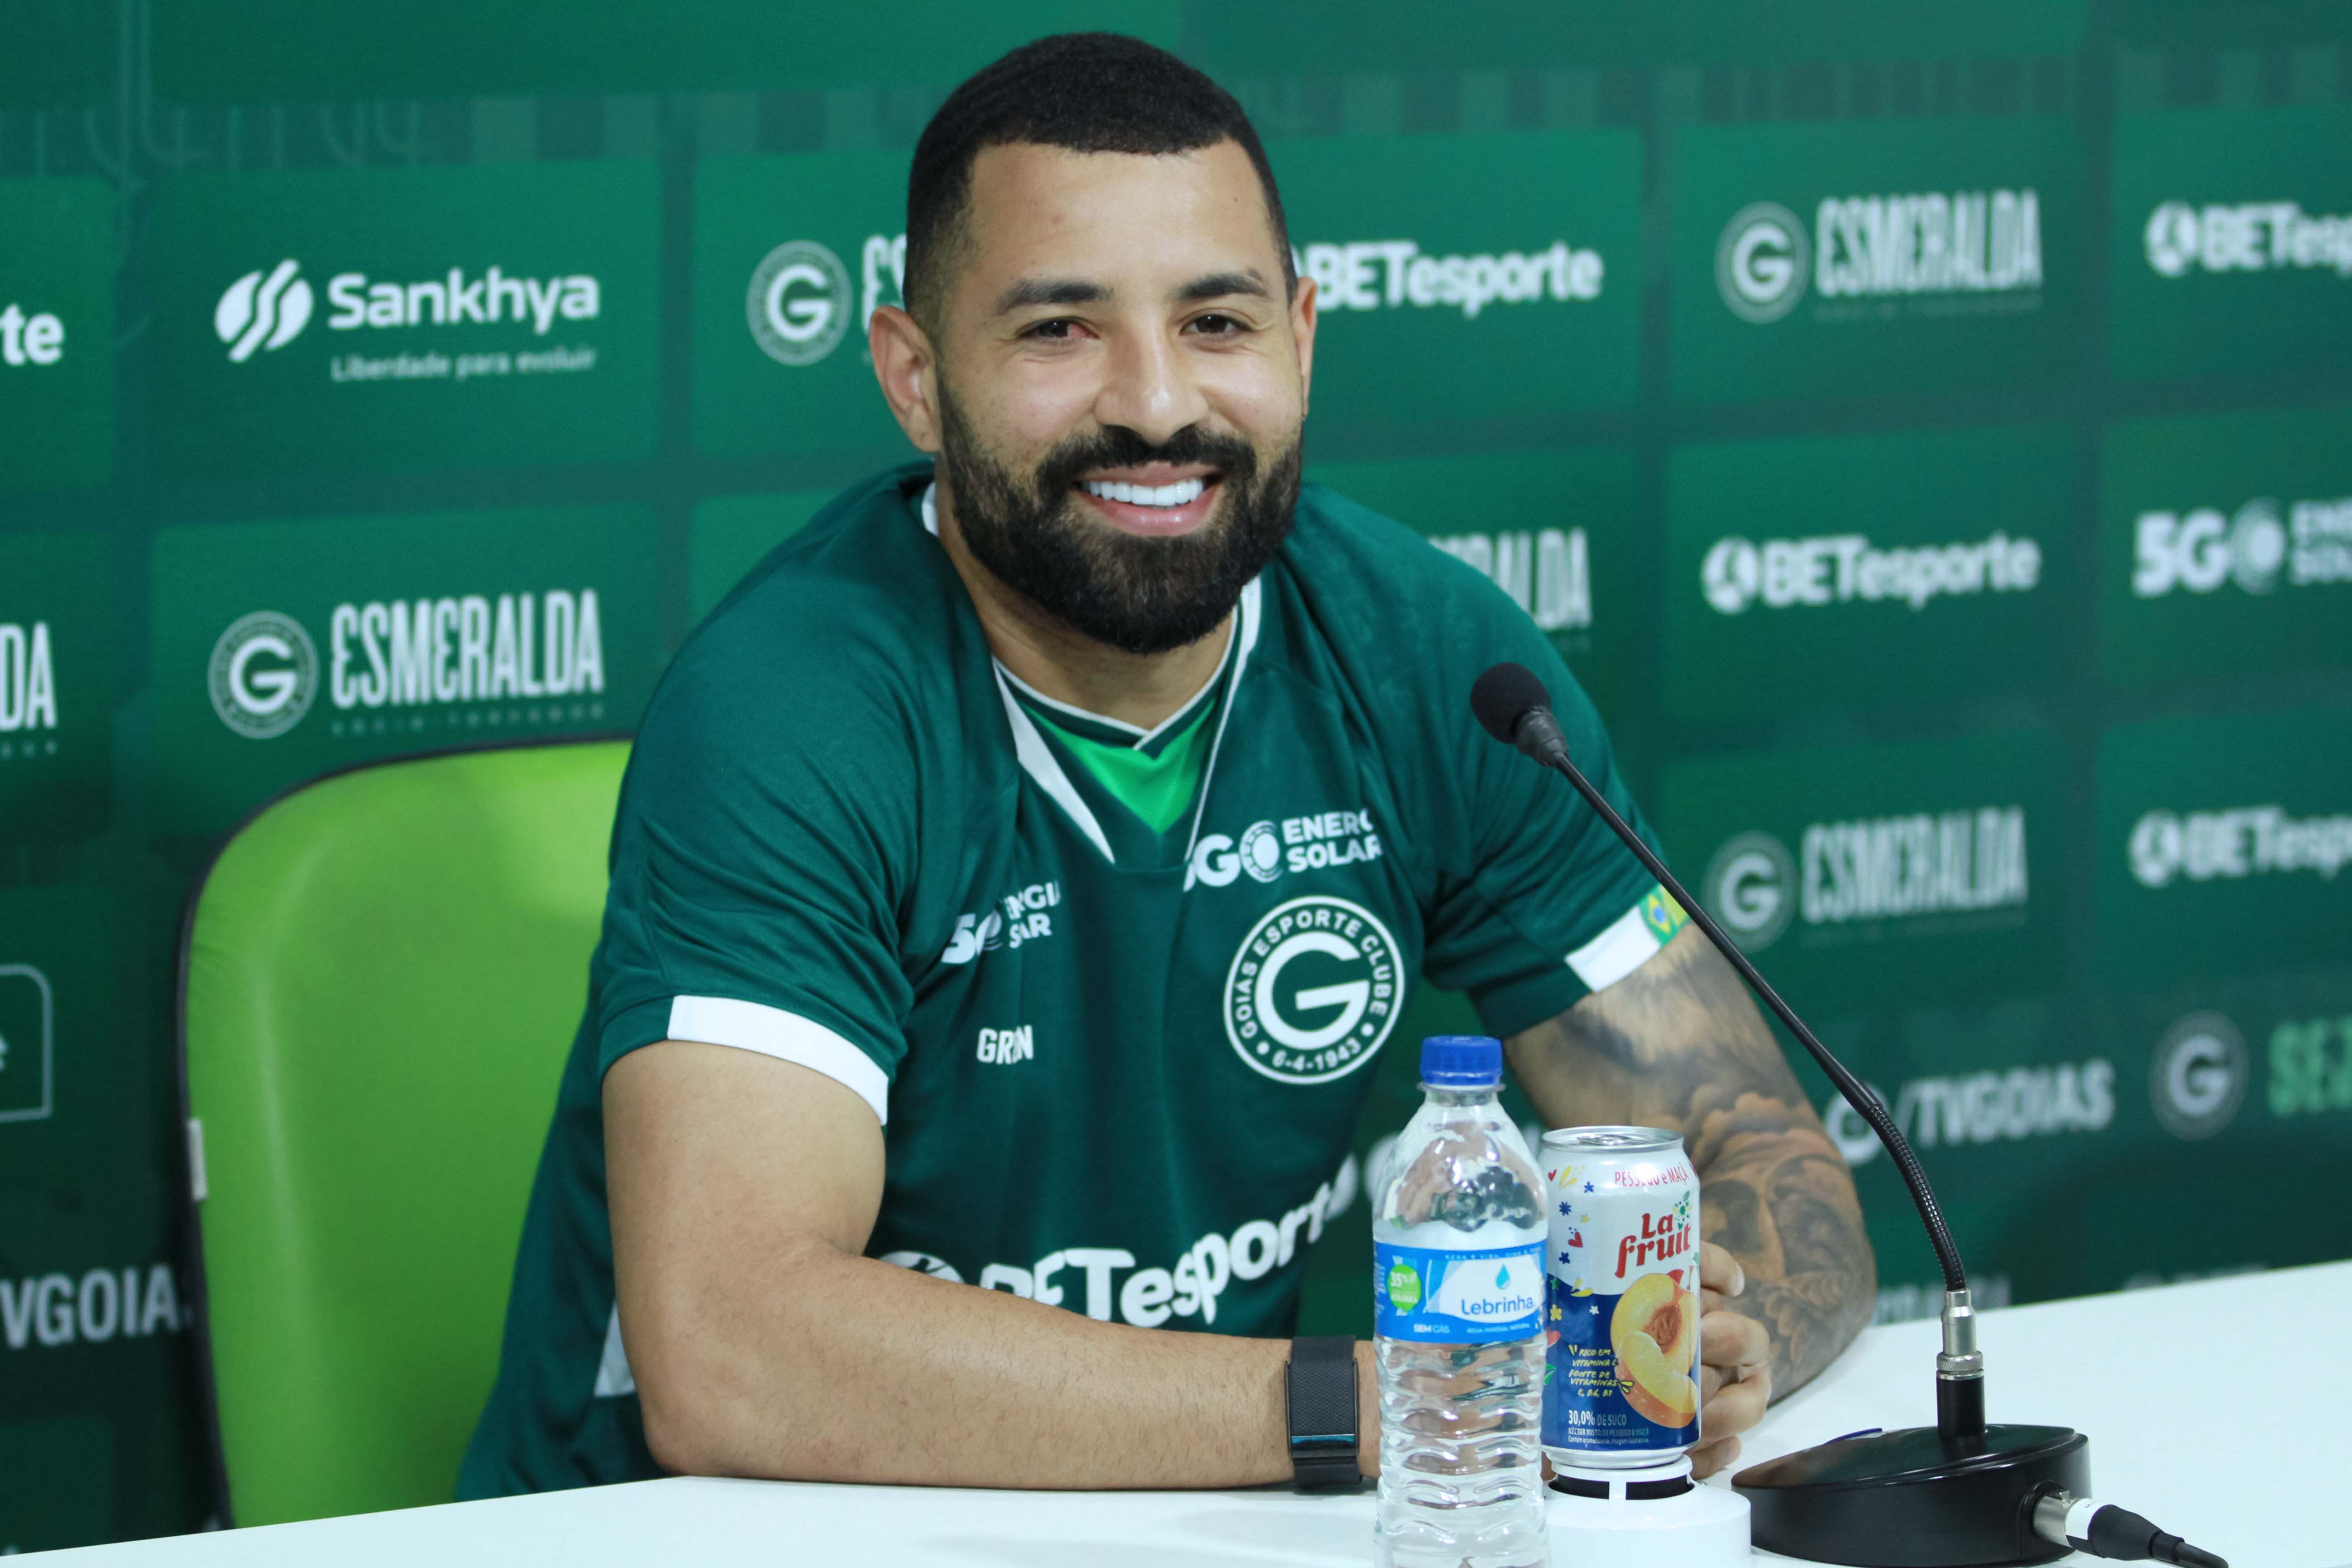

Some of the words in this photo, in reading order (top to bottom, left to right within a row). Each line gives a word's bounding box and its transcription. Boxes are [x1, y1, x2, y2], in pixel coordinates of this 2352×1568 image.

[1817, 187, 2044, 298] ESMERALDA
[328, 266, 600, 336] Sankhya
[1303, 238, 1605, 319] BETesporte
[331, 350, 450, 382] Liberdade
[456, 352, 510, 381] para
[515, 343, 597, 373] evoluir
[1427, 526, 1592, 630] ALDA
[1759, 529, 2041, 612] BETesporte
[2132, 508, 2231, 598] 5G
[331, 589, 605, 710] ESMERALDA
[1183, 833, 1241, 892] G
[941, 912, 985, 965] 5
[1253, 909, 1362, 957] ESPORTE
[1361, 934, 1392, 1017] CLUBE
[1254, 931, 1371, 1050] G
[1272, 1037, 1361, 1072] 6-4-1943
[1615, 1168, 1660, 1187] PÊSSO
[1662, 1173, 1668, 1185] e
[1614, 1222, 1691, 1279] fruit
[1641, 1213, 1673, 1240] La
[0, 1263, 193, 1350] VGOIA
[1413, 1323, 1431, 1333] SEM
[1461, 1295, 1534, 1315] Lebrinha
[1568, 1369, 1597, 1378] FONTE
[1571, 1377, 1618, 1386] VITAMINAS
[1568, 1409, 1596, 1426] 30,0%
[1597, 1414, 1607, 1426] DE
[1608, 1414, 1627, 1426] SUCO
